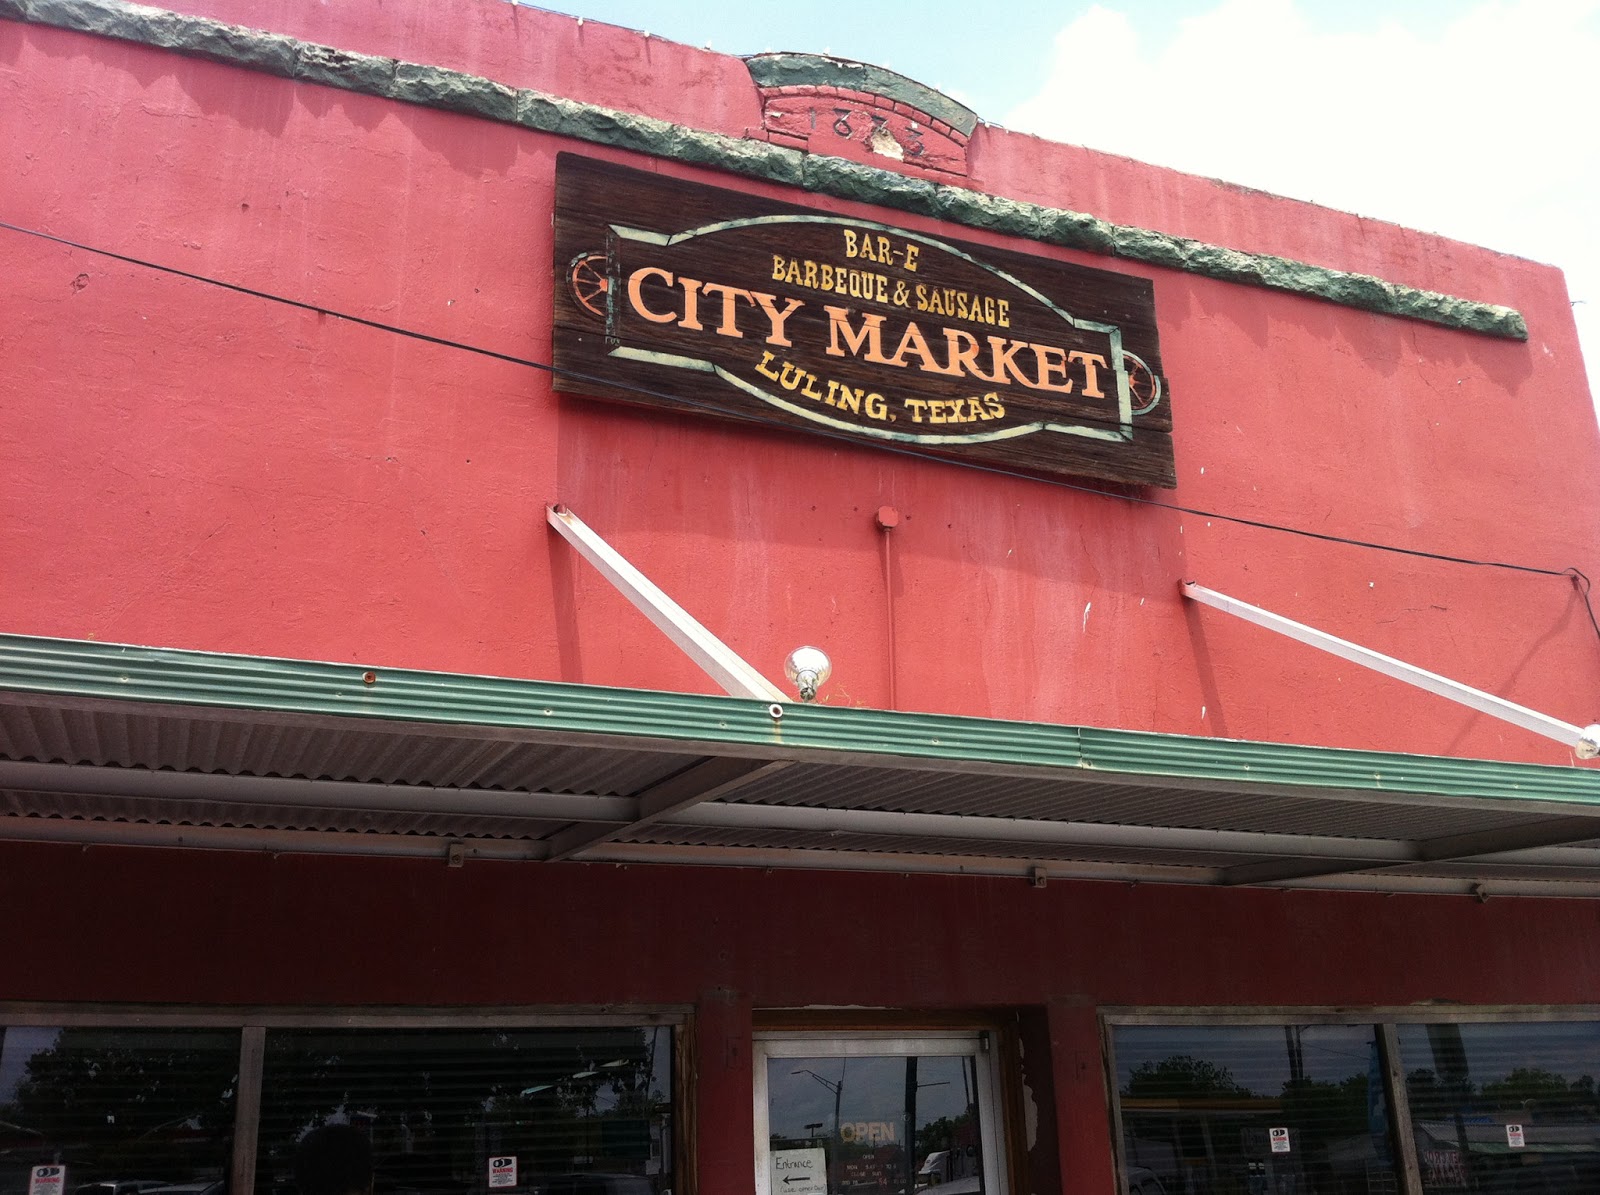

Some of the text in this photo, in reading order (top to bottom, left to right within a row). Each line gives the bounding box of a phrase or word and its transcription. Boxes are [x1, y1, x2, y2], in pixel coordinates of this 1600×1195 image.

[843, 229, 919, 272] BAR-E
[772, 255, 1010, 328] BARBEQUE & SAUSAGE
[628, 266, 1108, 399] CITY MARKET
[754, 351, 1006, 424] LULING, TEXAS
[840, 1121, 896, 1142] OPEN
[775, 1156, 813, 1170] Entrance
